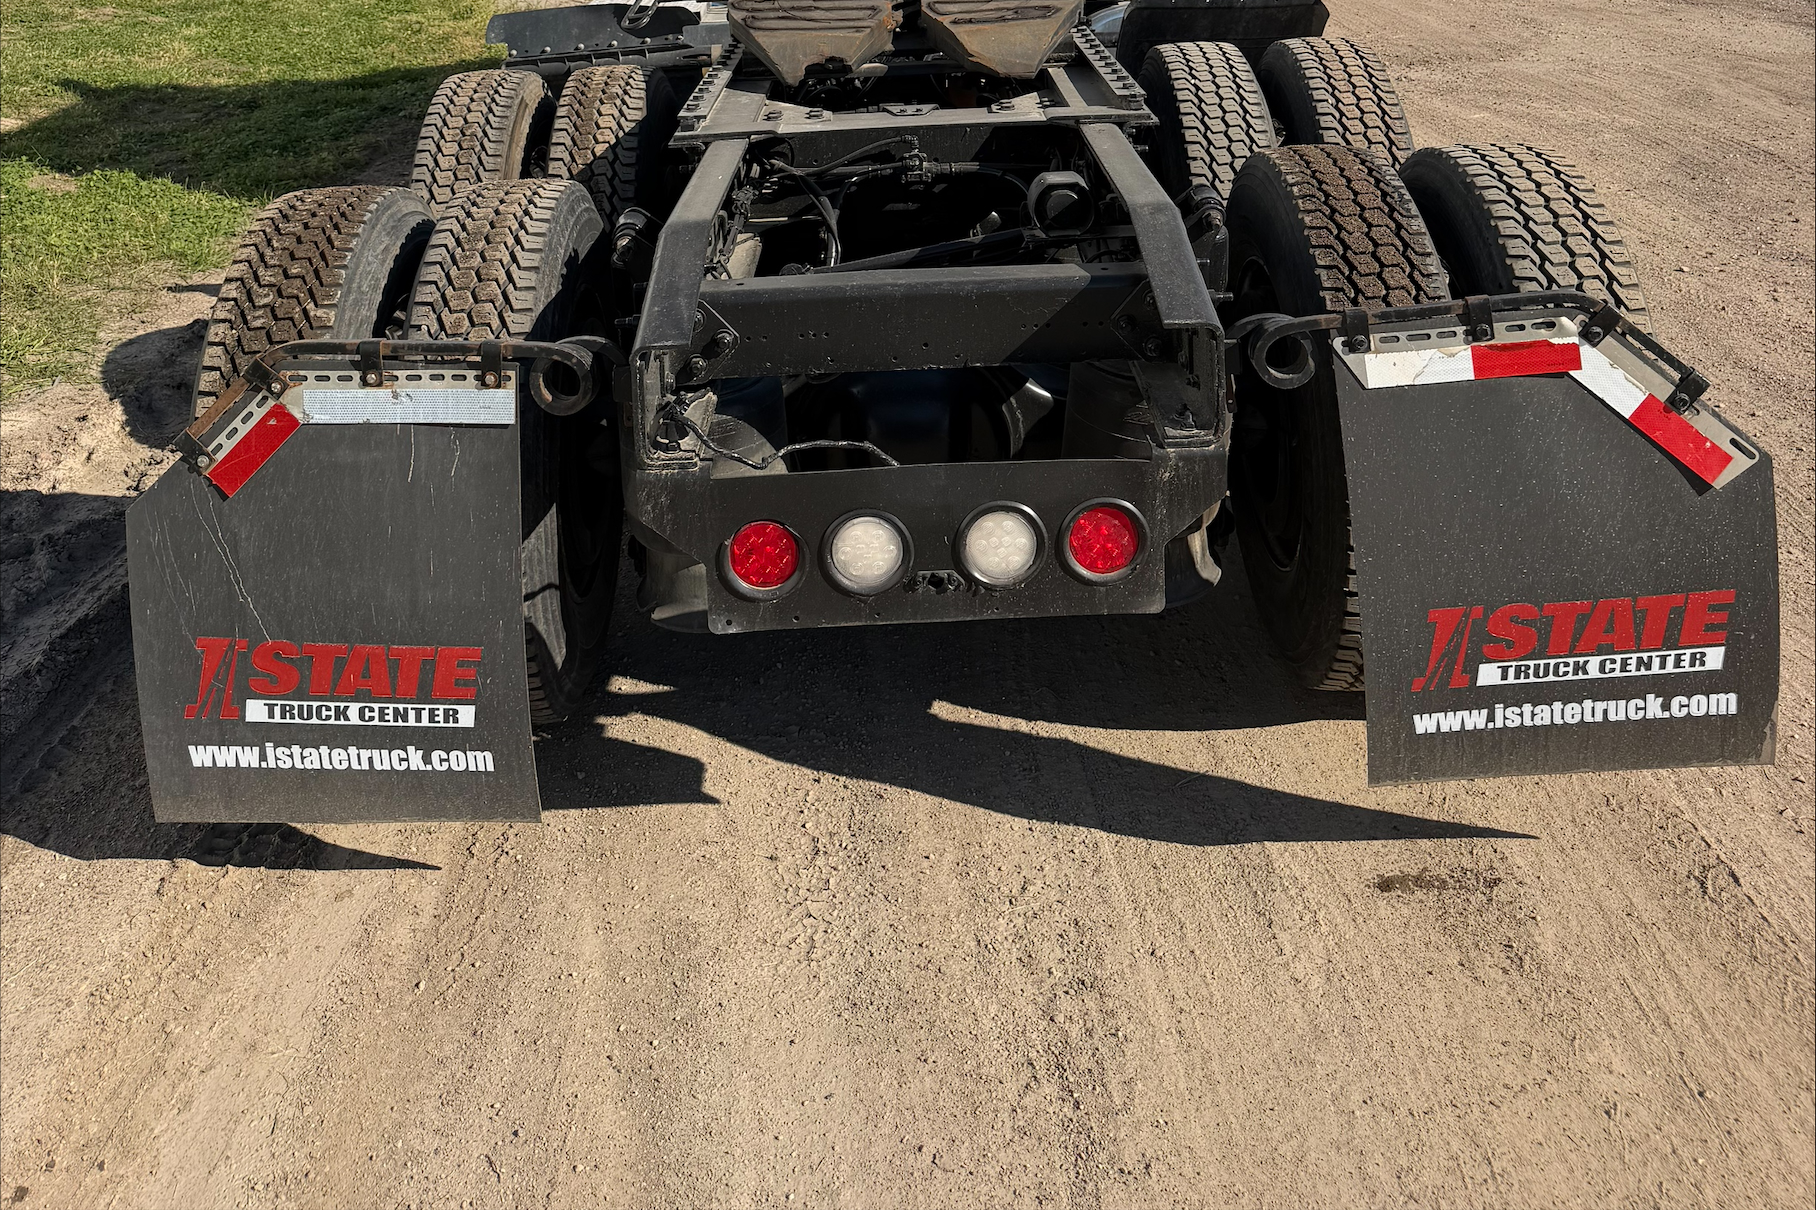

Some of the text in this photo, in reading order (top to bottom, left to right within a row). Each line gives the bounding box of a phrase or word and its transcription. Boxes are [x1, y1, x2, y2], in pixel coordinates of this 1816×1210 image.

[1497, 651, 1706, 682] TRUCK CENTER
[263, 702, 459, 724] TRUCK CENTER
[1412, 692, 1738, 735] www.istatetruck.com
[187, 742, 495, 773] www.istatetruck.com
